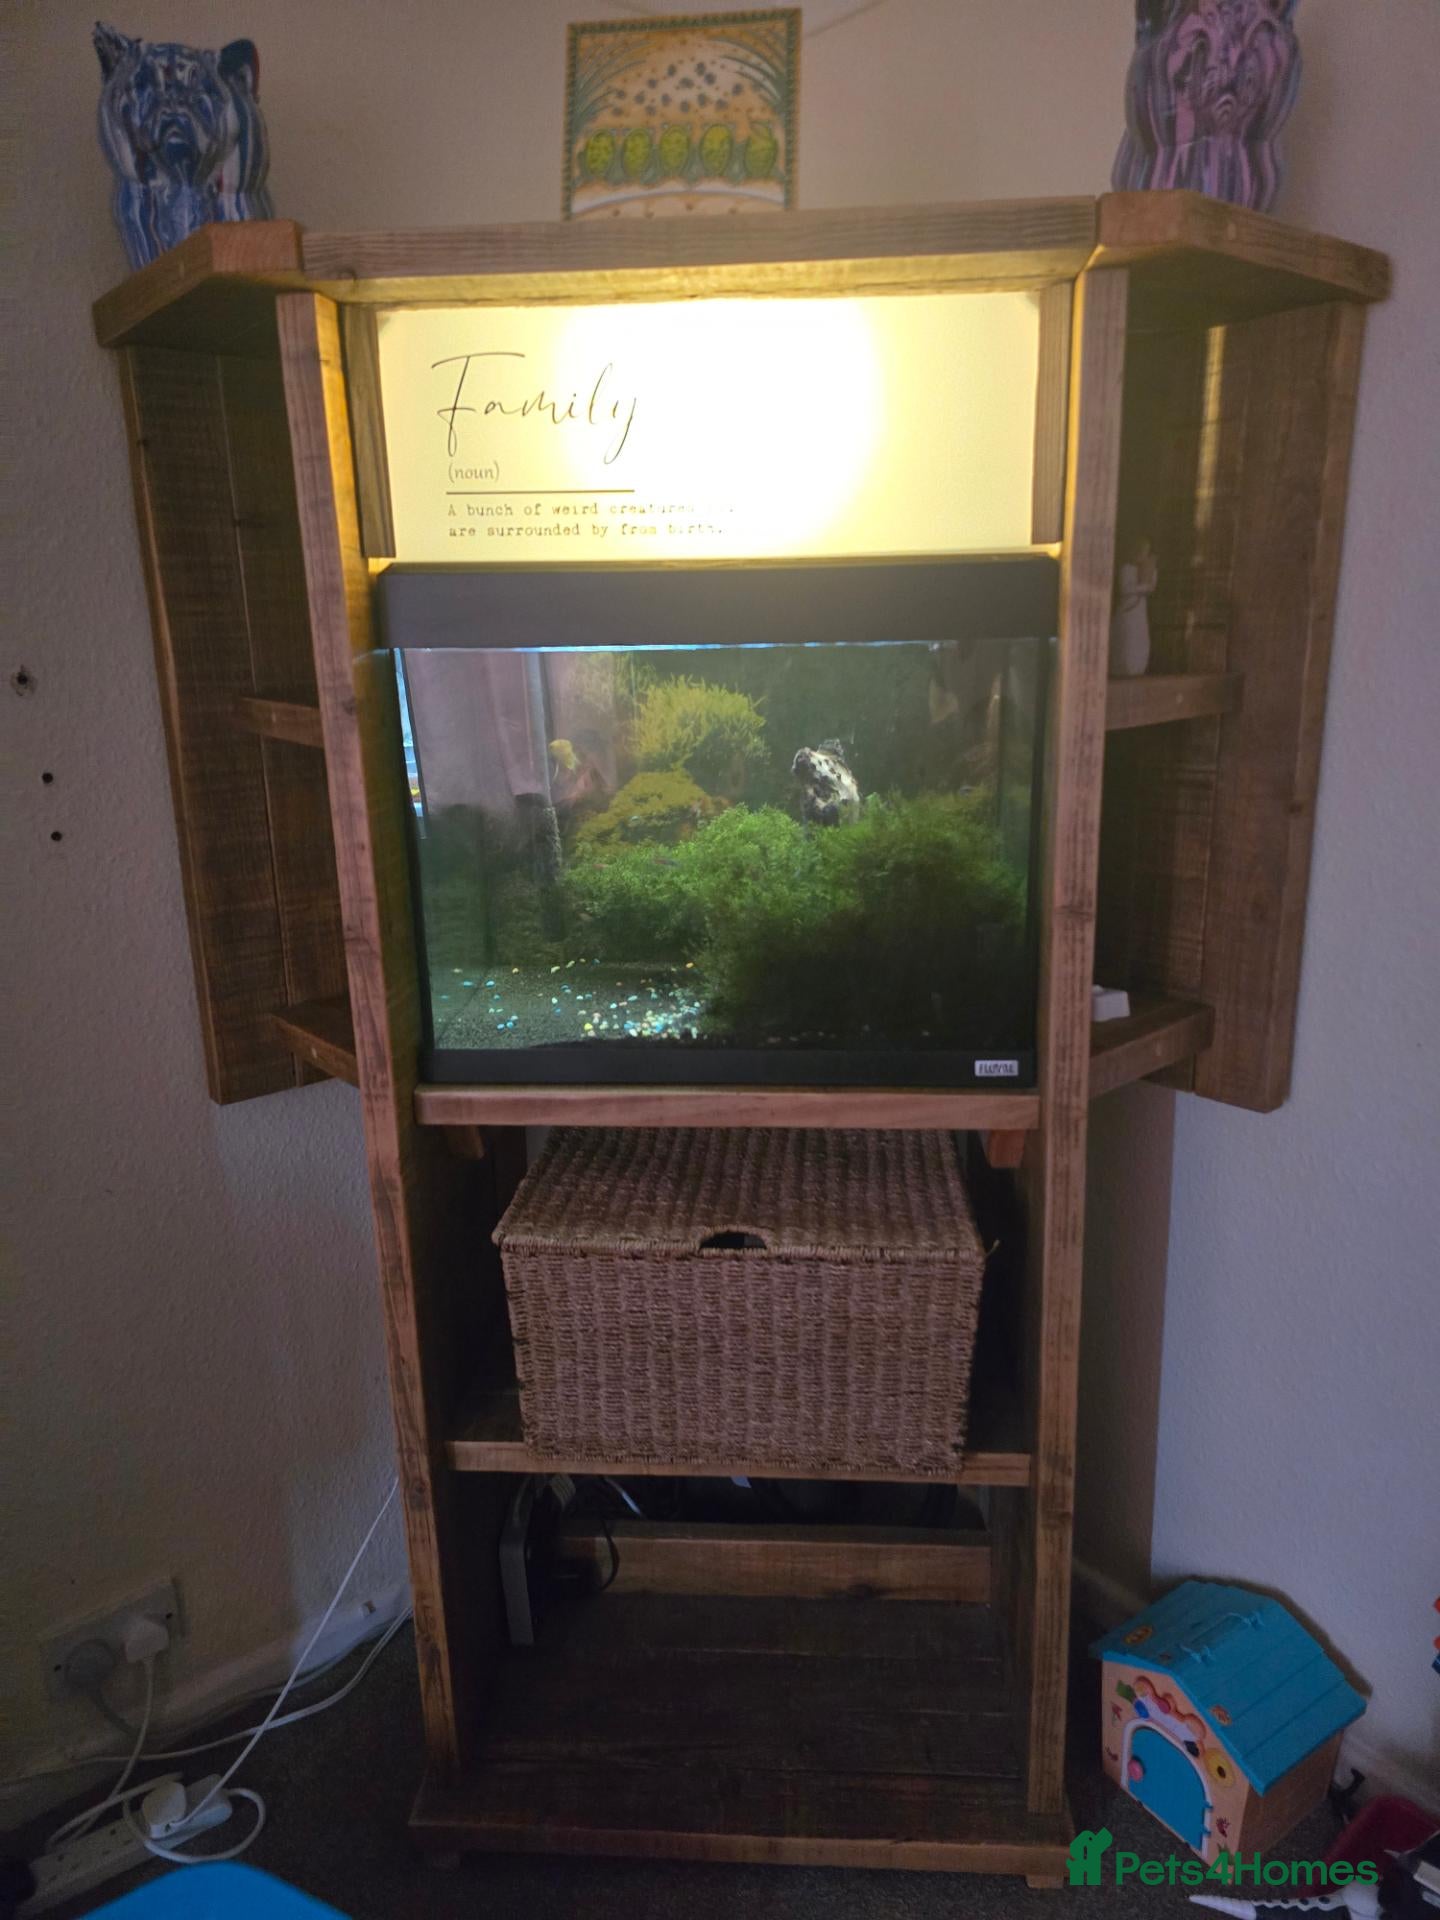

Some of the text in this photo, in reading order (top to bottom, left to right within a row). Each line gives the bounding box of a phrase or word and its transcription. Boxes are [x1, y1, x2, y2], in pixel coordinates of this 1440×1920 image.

[431, 351, 638, 464] Family
[448, 461, 500, 484] (noun)
[448, 504, 457, 516] A
[466, 502, 514, 516] bunch
[523, 502, 541, 516] of
[551, 502, 599, 516] weird
[448, 525, 477, 538] are
[487, 523, 580, 537] surrounded
[592, 523, 609, 538] by
[620, 523, 657, 536] from
